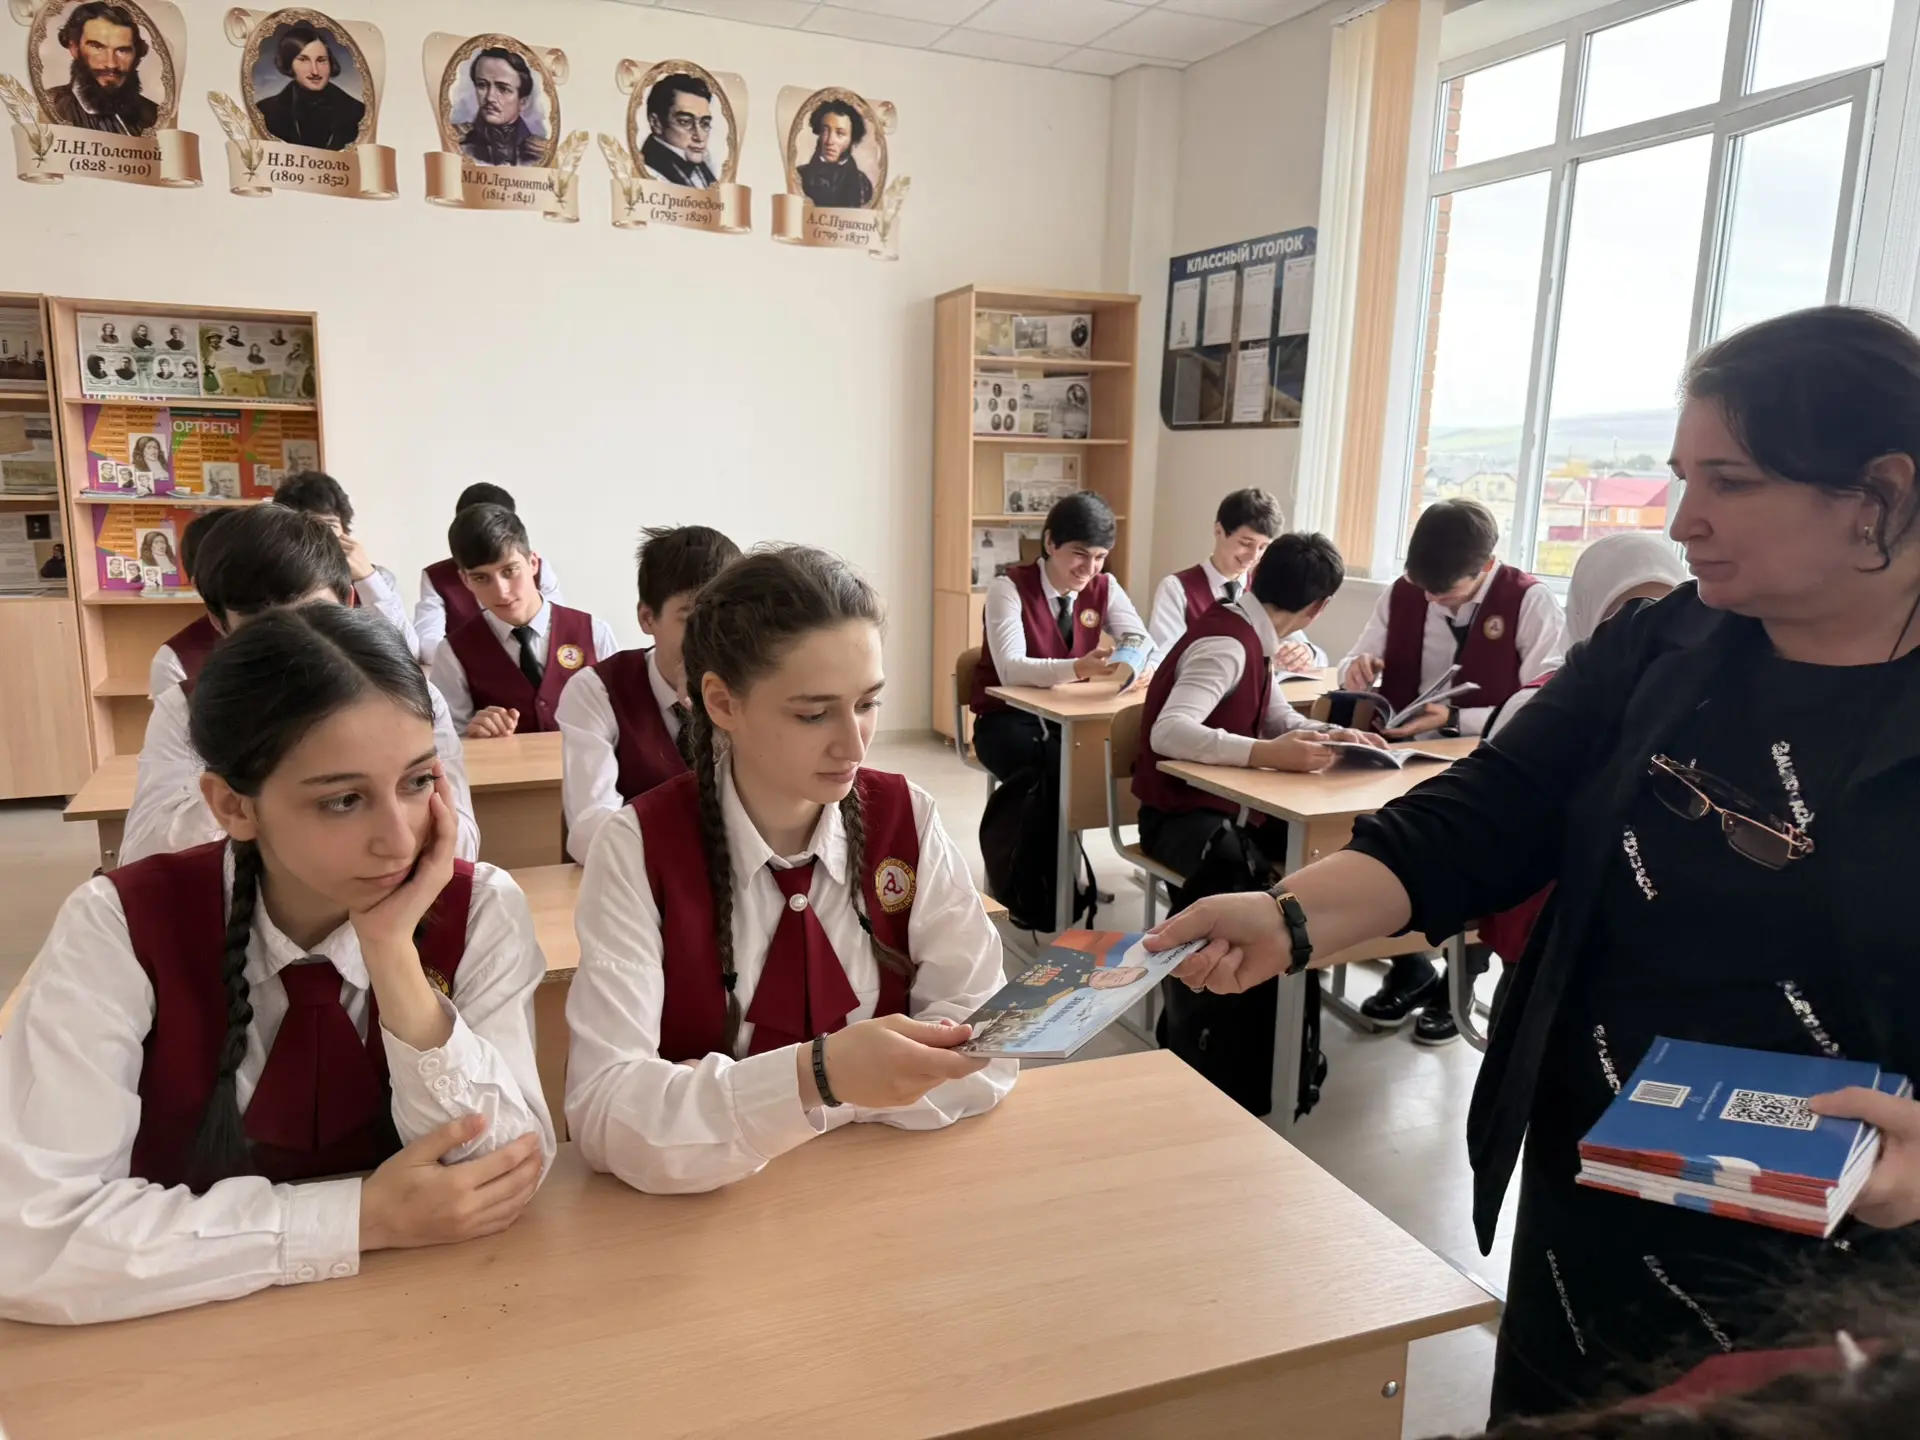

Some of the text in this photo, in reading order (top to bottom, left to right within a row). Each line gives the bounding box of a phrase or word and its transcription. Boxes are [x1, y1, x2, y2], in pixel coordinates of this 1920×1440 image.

[53, 139, 163, 162] Л.Н.Толстой
[69, 158, 106, 172] (1828
[117, 164, 152, 177] 1910)
[267, 152, 351, 172] Н.В.Гоголь
[270, 169, 305, 185] (1809
[317, 173, 350, 188] 1852)
[461, 170, 555, 192] М.Ю.Лермонтов
[481, 187, 506, 202] (1814
[512, 191, 536, 205] 1841)
[637, 191, 725, 212] А.С.Грибоедов
[650, 208, 678, 222] (1795
[685, 212, 713, 225] 1829)
[806, 212, 876, 233] А.С.Пушкин
[813, 228, 838, 242] (1799
[845, 232, 871, 245] 1837)
[1186, 234, 1305, 274] КЛАССНЫЙ УГОЛОК
